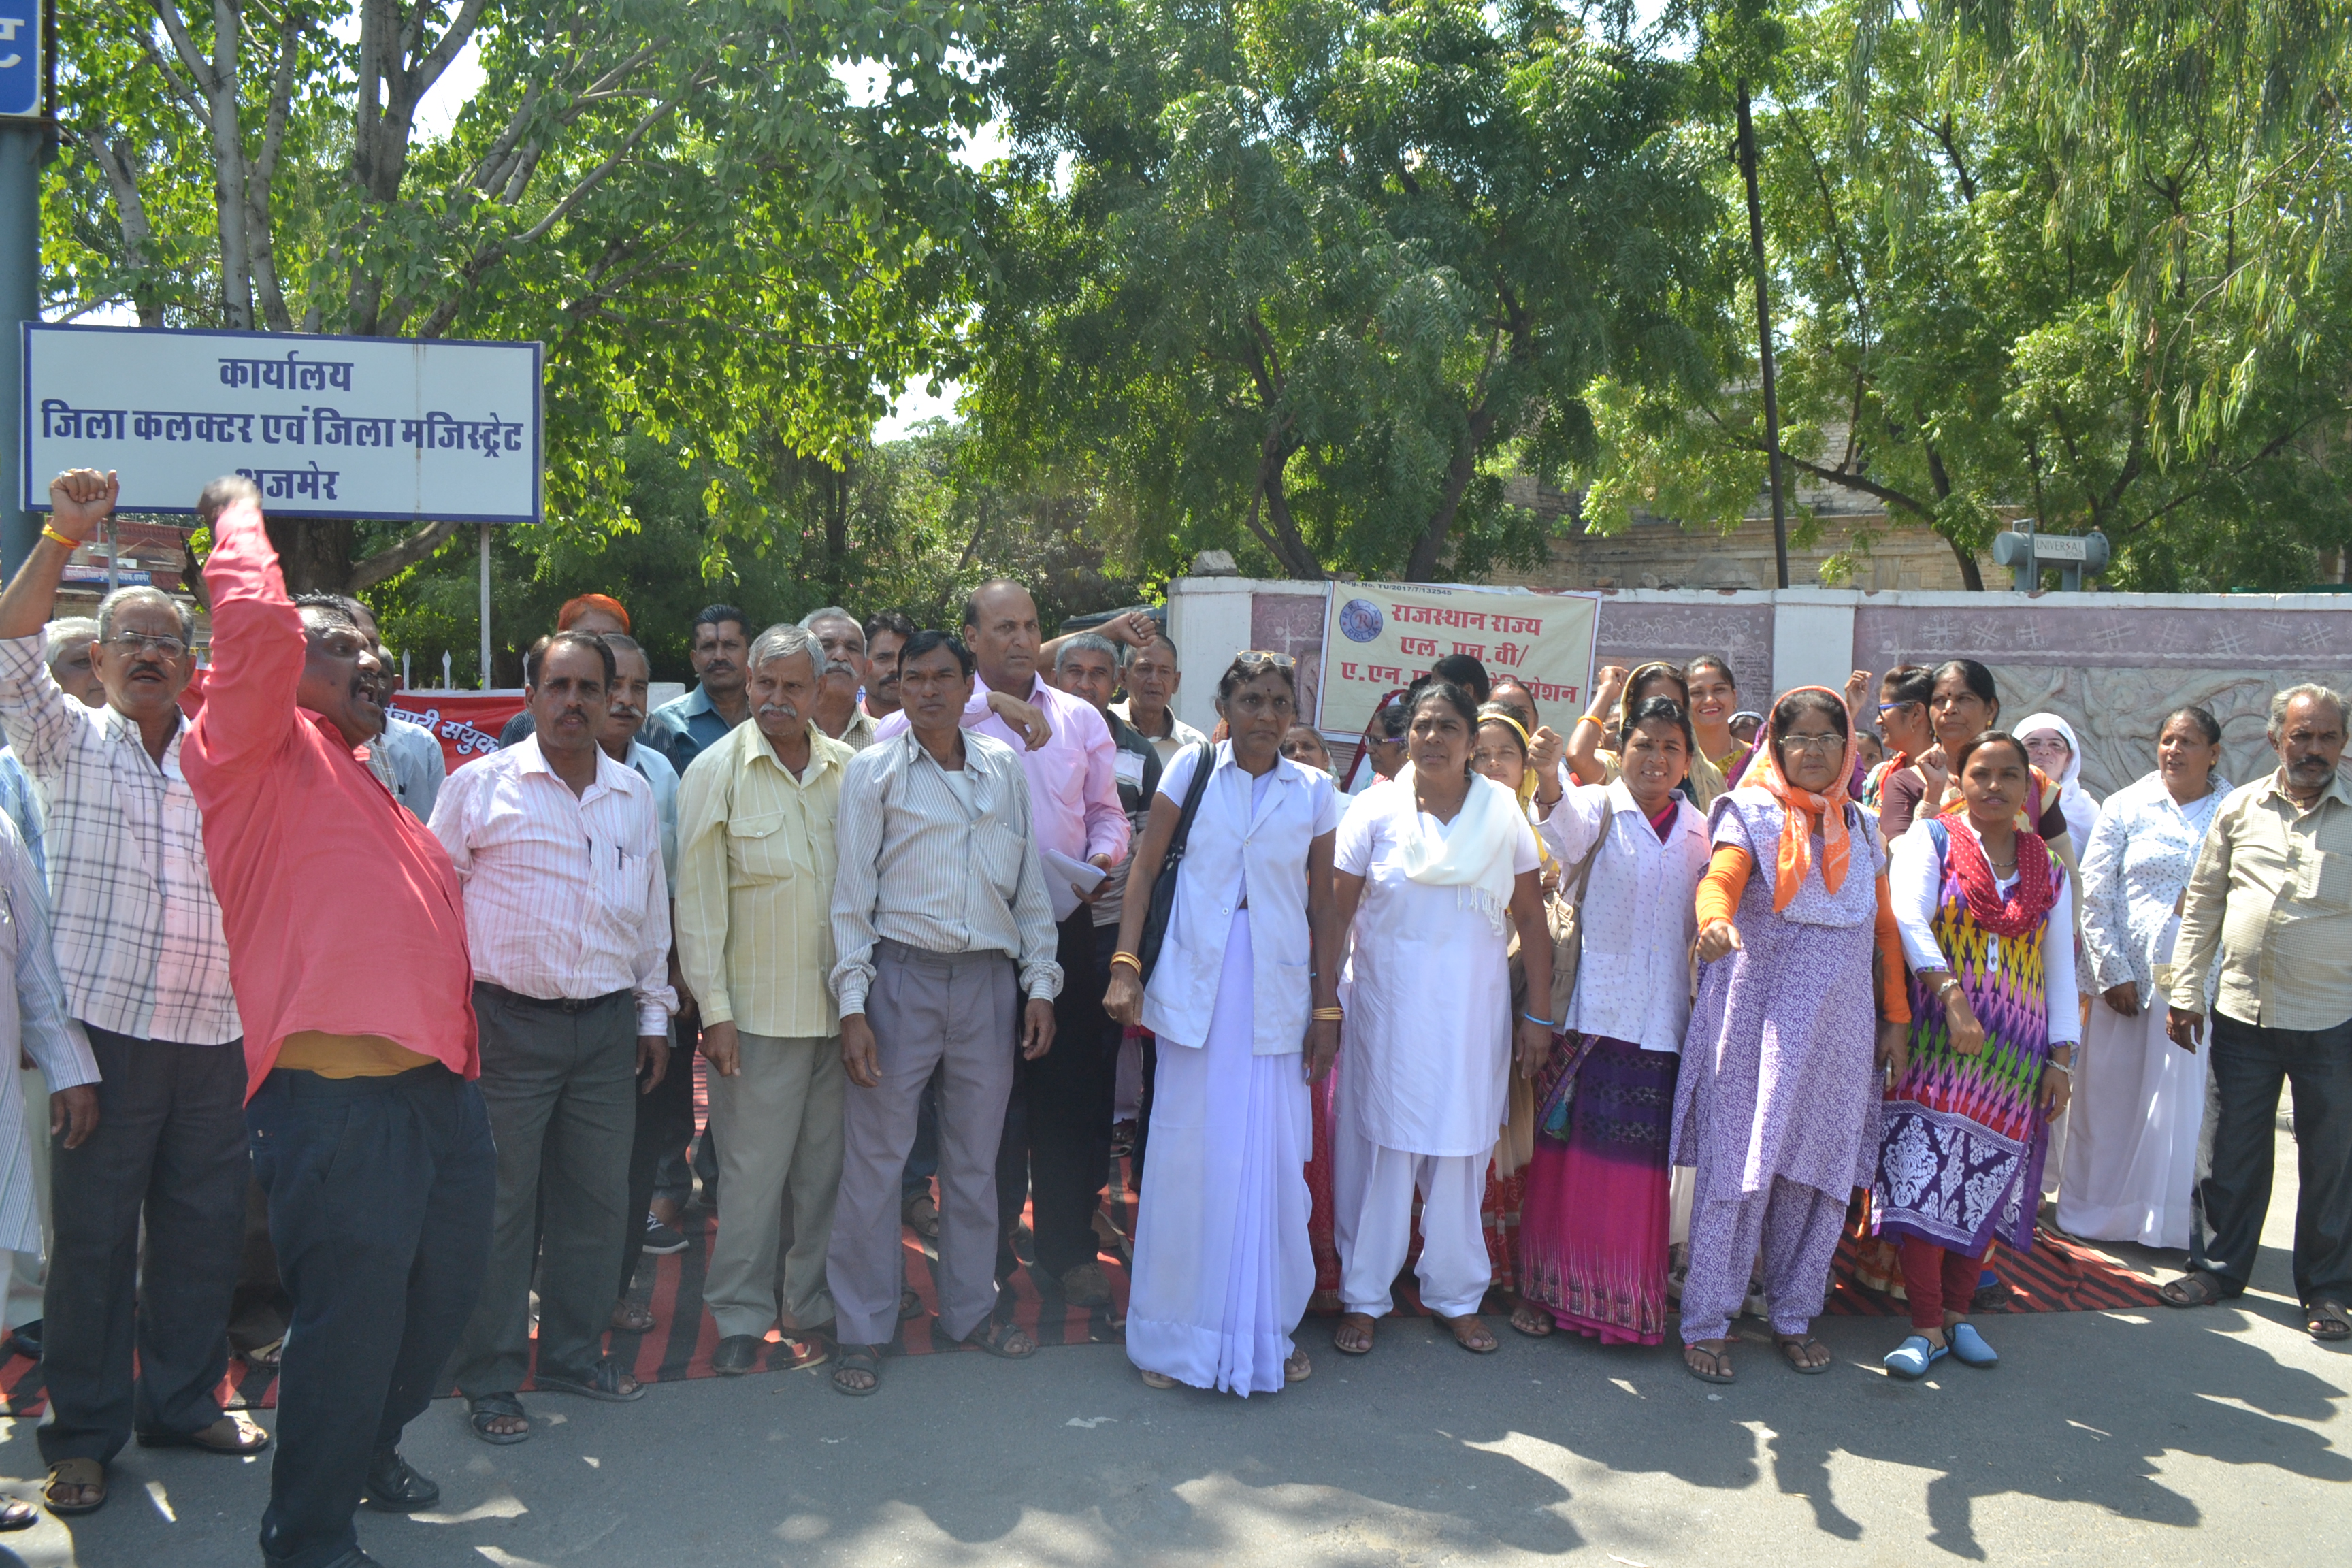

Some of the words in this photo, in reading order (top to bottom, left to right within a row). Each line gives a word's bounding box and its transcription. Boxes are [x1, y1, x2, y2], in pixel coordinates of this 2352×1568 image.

[218, 350, 354, 391] कार्यालय
[42, 399, 127, 438] जिला
[133, 410, 254, 443] कलक्टर
[261, 406, 310, 444] एवं
[313, 408, 395, 448] जिला
[401, 411, 523, 457] मजिस्ट्रेट
[2036, 540, 2083, 552] UNIVERSAL
[1378, 583, 1452, 596] TU/2017/7/132545
[1392, 604, 1488, 631] राजस्थान
[1492, 614, 1544, 636] राज्य
